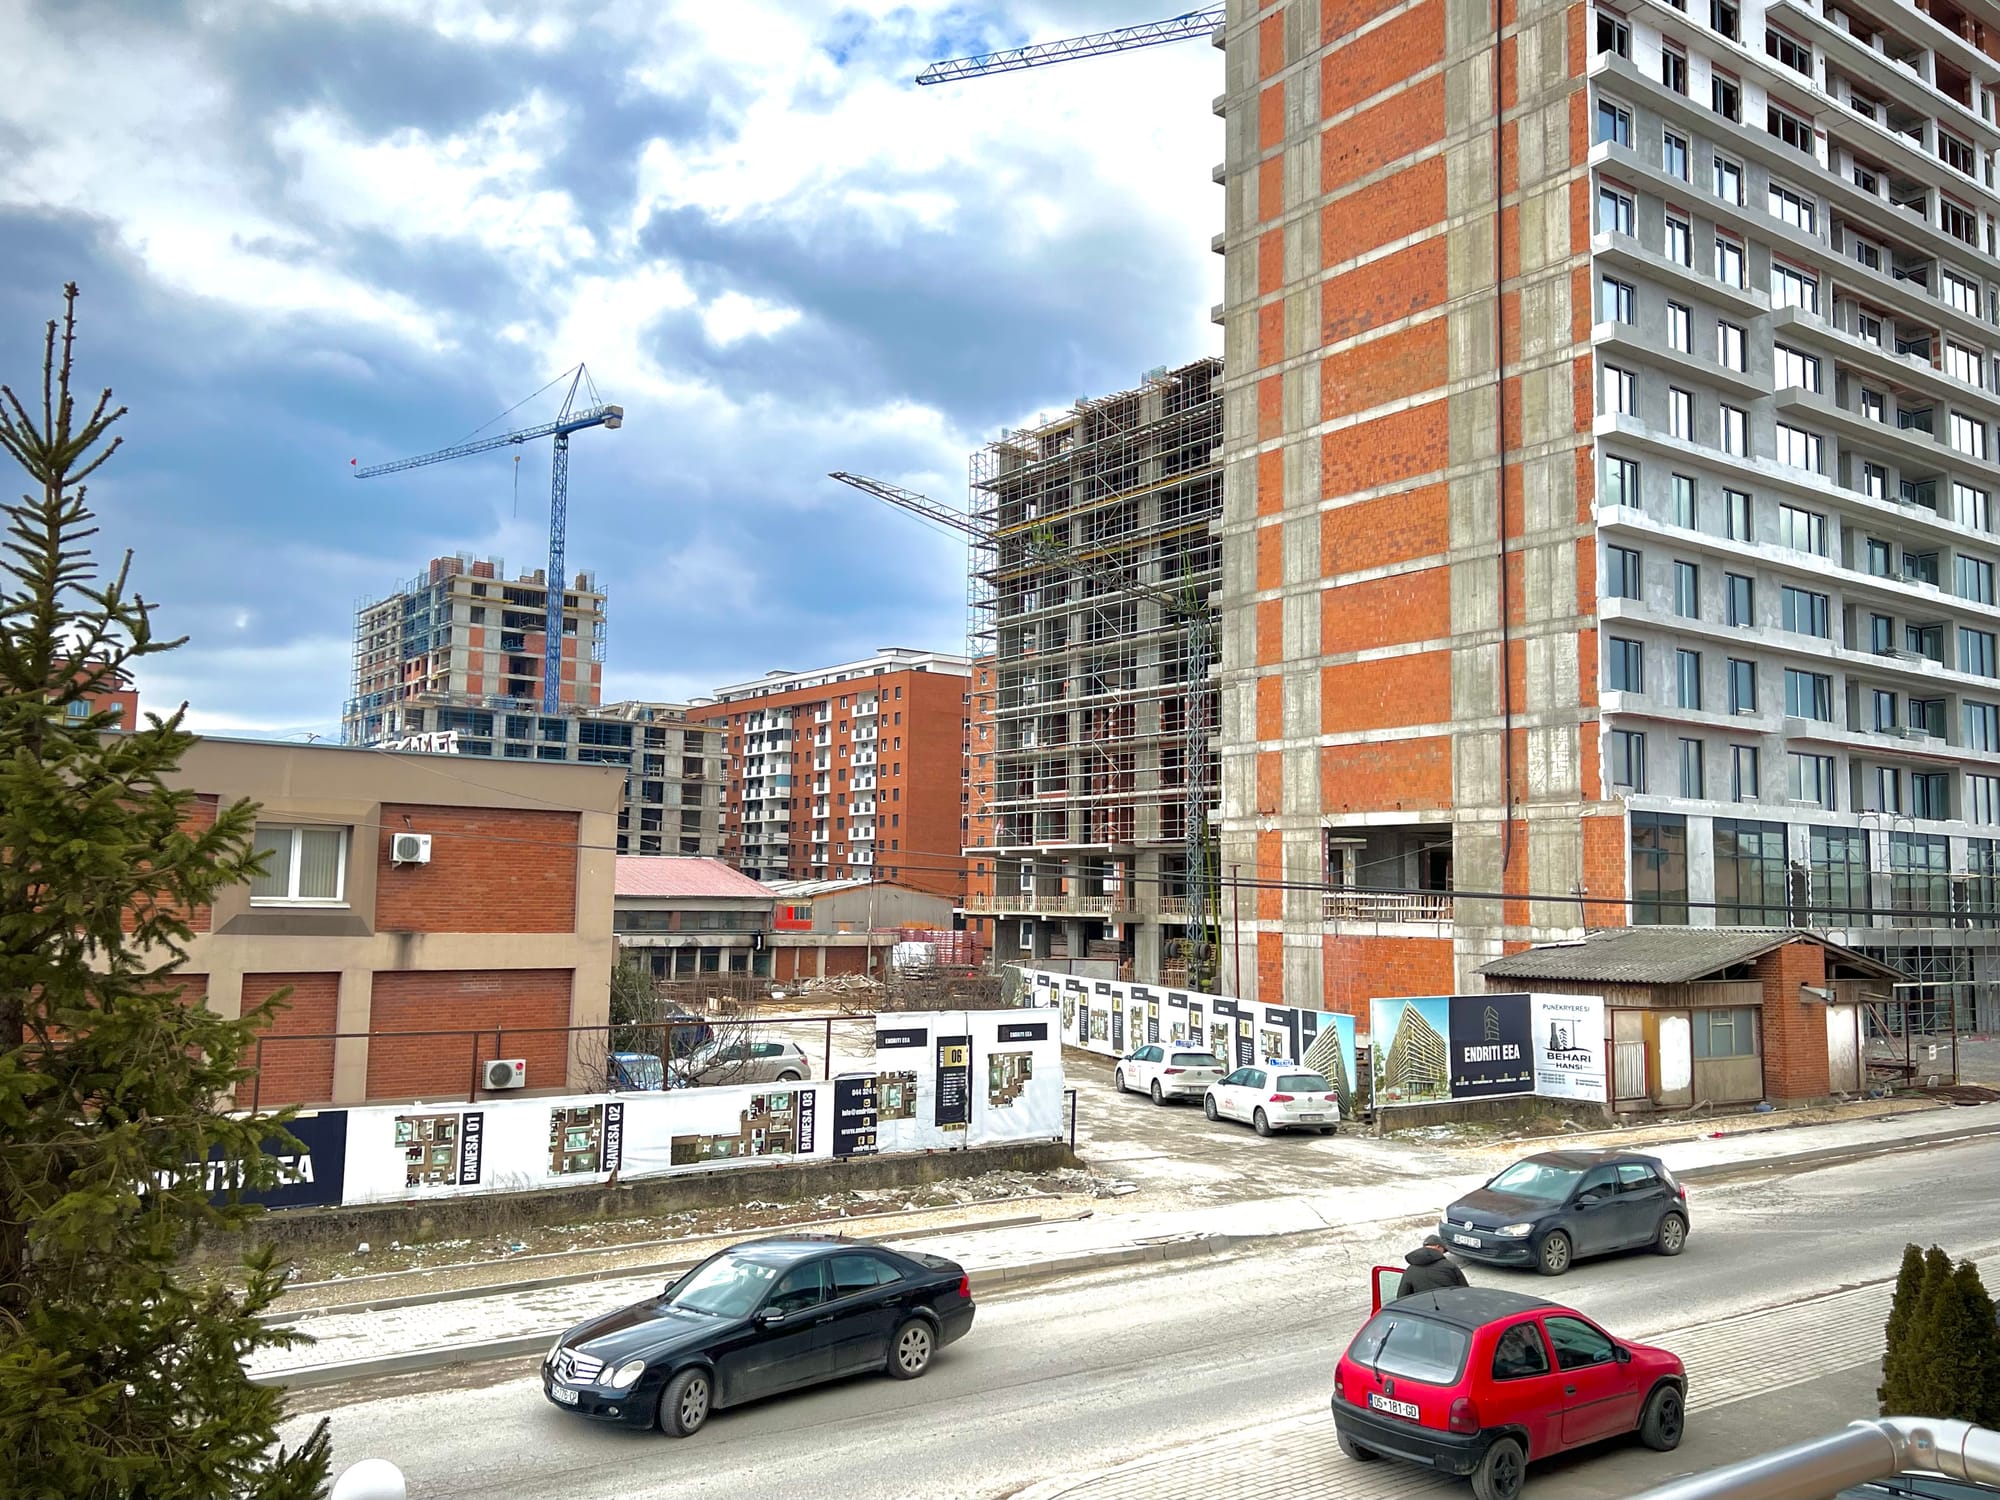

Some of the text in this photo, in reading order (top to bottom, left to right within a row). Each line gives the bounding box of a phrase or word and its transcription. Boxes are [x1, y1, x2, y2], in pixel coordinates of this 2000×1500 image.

[952, 1049, 962, 1063] 06
[1464, 1044, 1520, 1063] ENDRITI EEA
[1547, 1052, 1591, 1063] BEHARI
[1556, 1062, 1583, 1070] HANSI
[801, 1092, 813, 1150] BANESA 03
[606, 1105, 620, 1169] BANESA 02
[463, 1116, 480, 1182] BANESA 01
